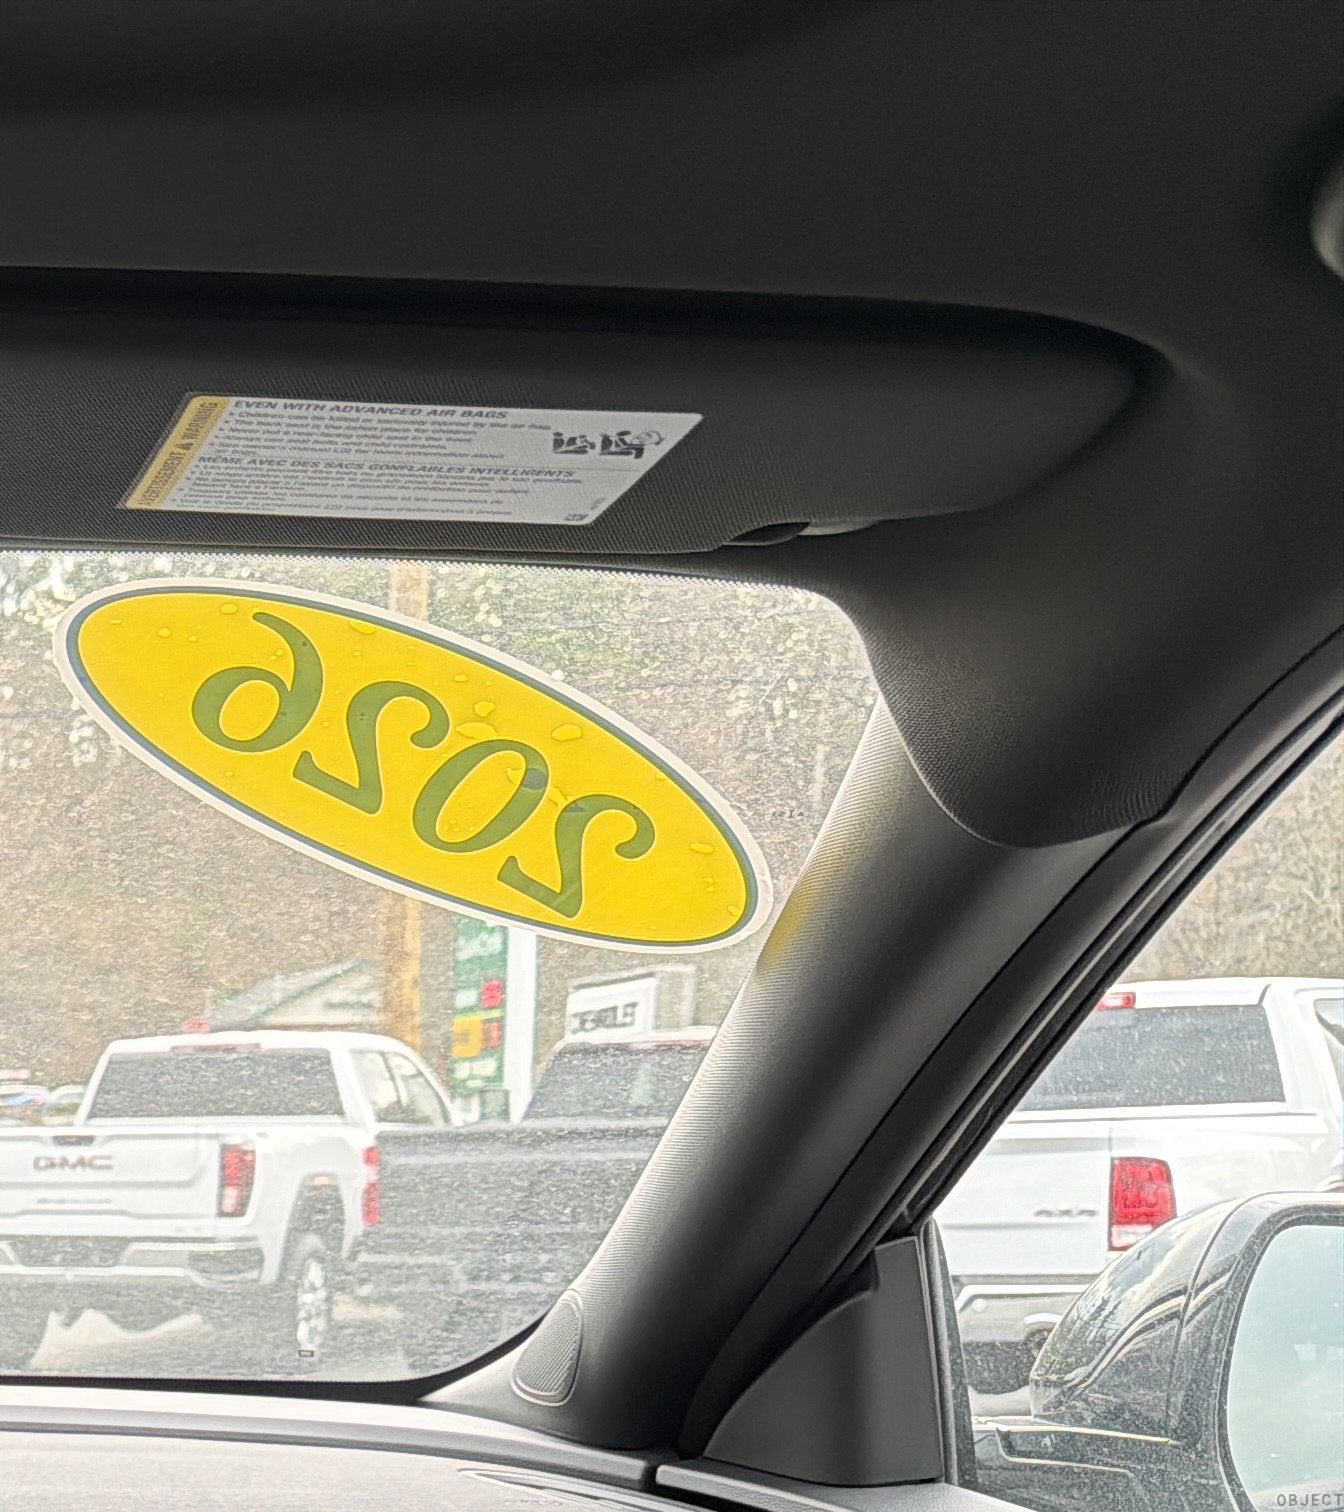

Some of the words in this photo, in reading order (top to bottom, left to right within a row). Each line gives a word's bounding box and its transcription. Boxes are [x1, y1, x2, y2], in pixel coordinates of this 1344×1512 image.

[233, 400, 271, 411] EVEN
[274, 402, 327, 413] WITH
[331, 403, 423, 417] ADVANCED
[427, 408, 458, 418] AIR
[462, 410, 508, 419] BAGS
[248, 457, 288, 467] AVEC
[290, 458, 322, 469] DES
[326, 460, 366, 471] SACS
[467, 467, 575, 479] INTELLIGENTS
[33, 1155, 114, 1171] GMC
